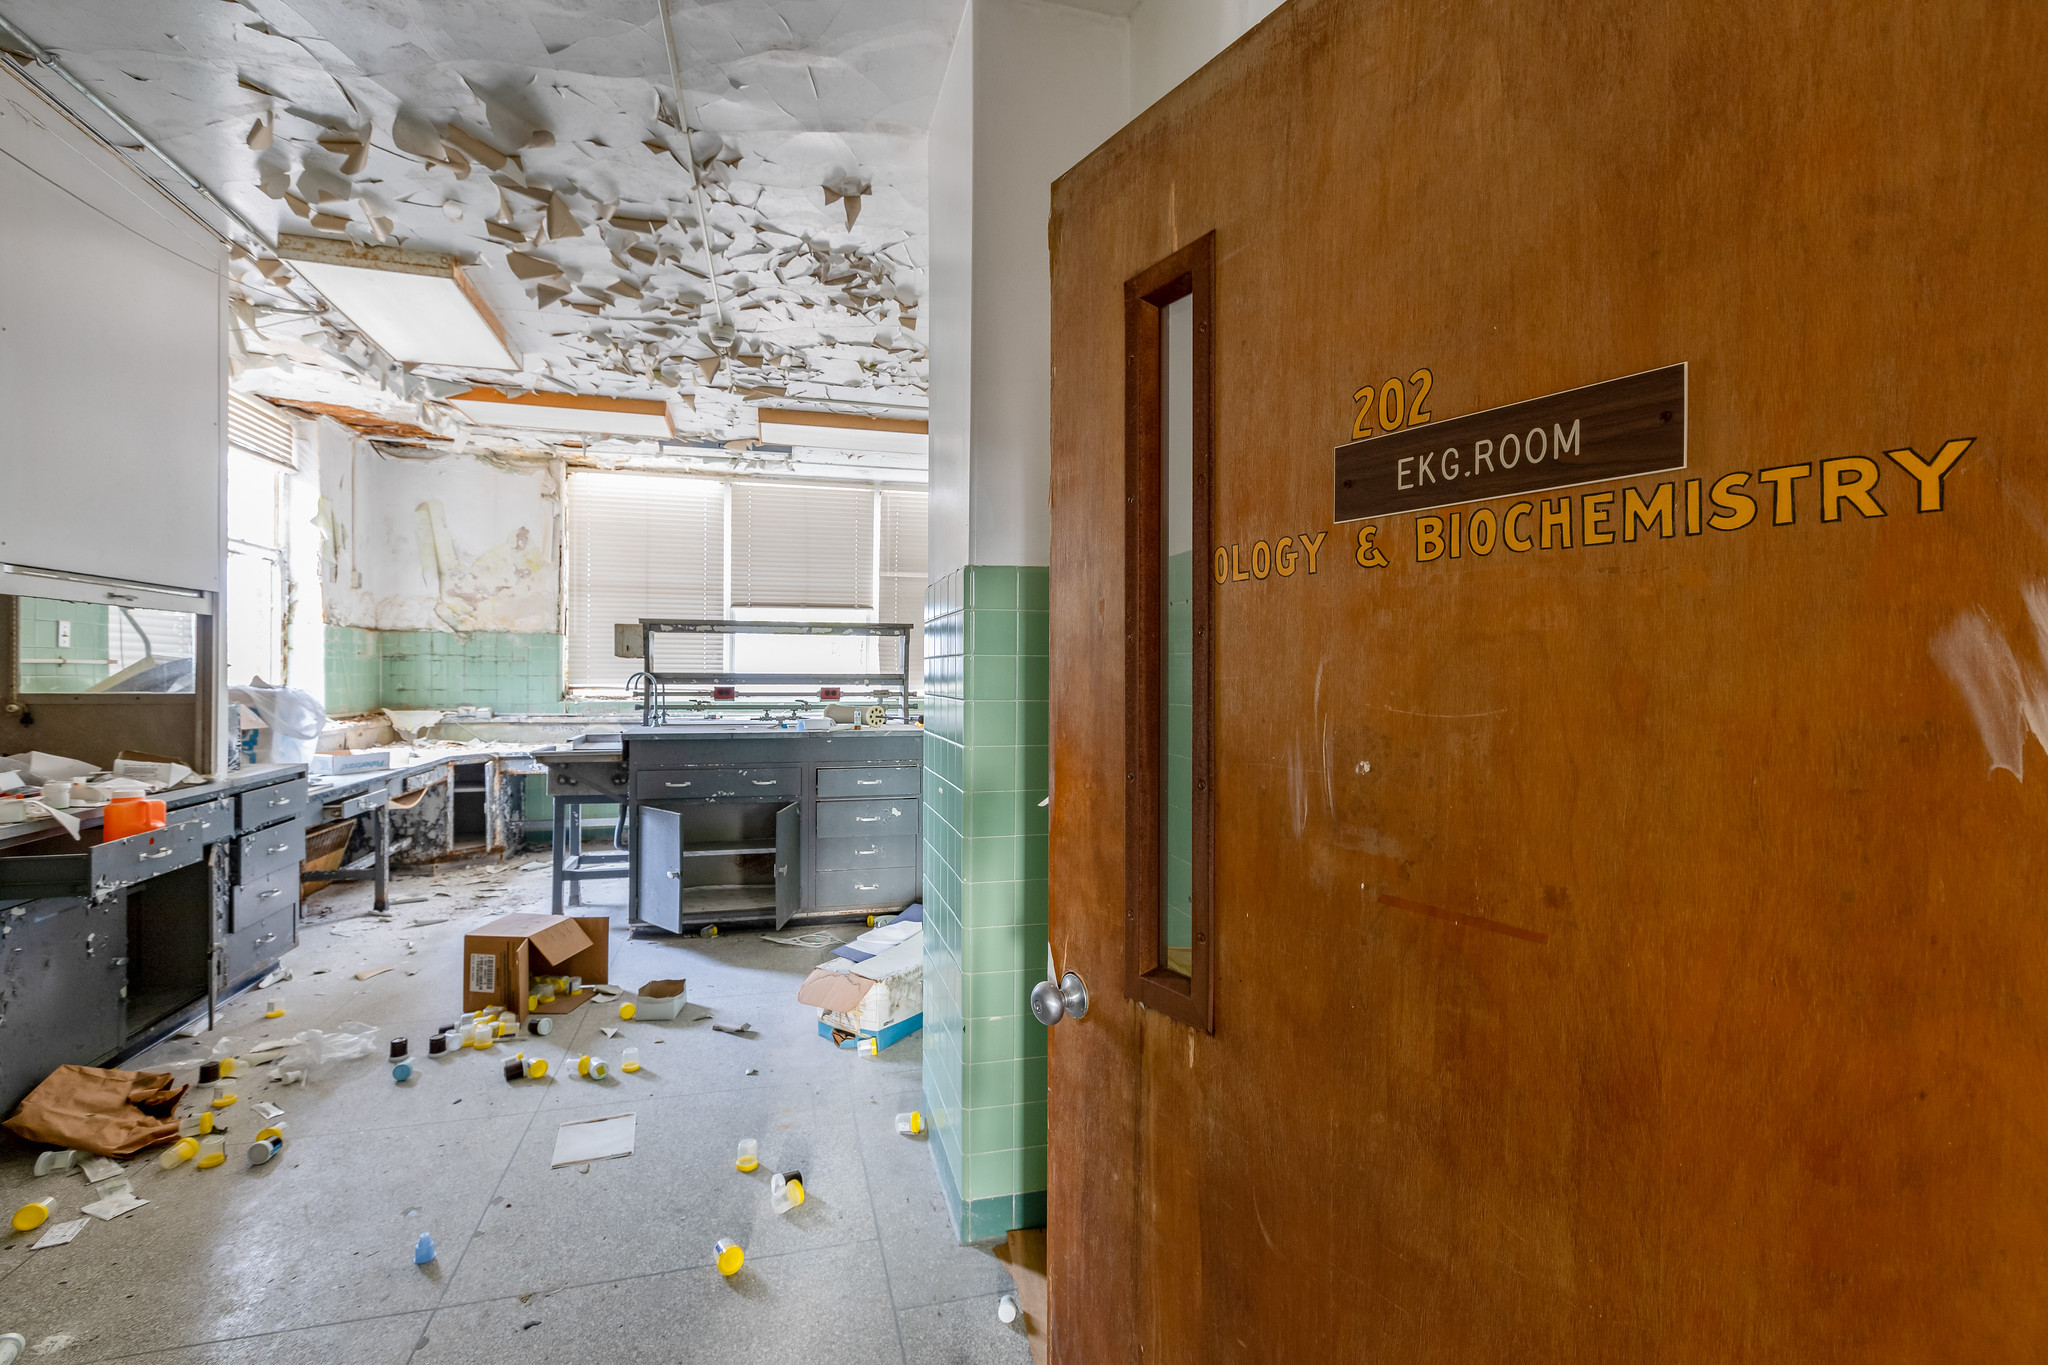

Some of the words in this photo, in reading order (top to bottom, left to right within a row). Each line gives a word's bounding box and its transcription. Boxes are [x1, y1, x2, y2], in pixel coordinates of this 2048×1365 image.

[1351, 367, 1434, 441] 202
[1355, 525, 1390, 569] &
[1415, 436, 1977, 563] BIOCHEMISTRY
